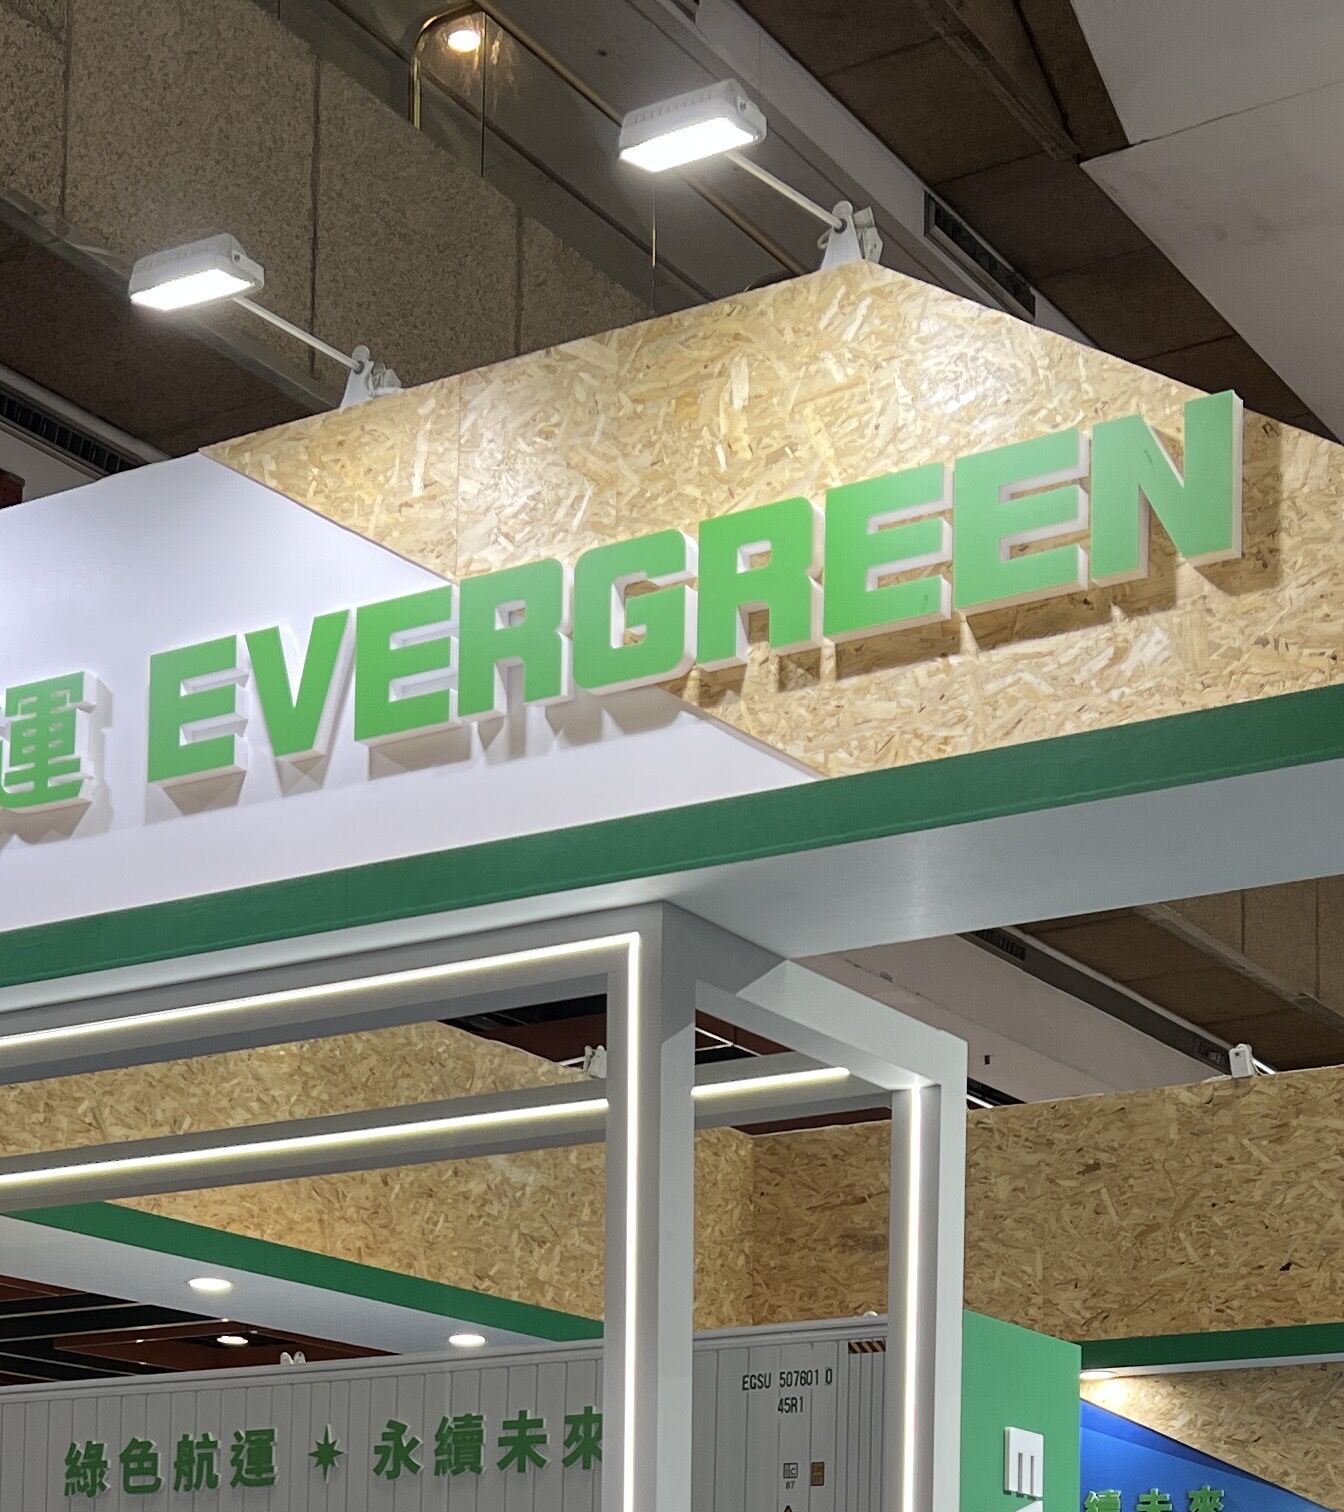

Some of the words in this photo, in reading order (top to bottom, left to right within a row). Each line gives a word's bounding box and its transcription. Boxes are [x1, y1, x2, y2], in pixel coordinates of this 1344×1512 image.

[147, 389, 1242, 783] EVERGREEN
[742, 1373, 772, 1391] EGSU
[779, 1369, 819, 1388] 507601
[777, 1396, 804, 1414] 45R1
[63, 1427, 279, 1498] 綠色航運
[372, 1405, 602, 1481] 永續未來
